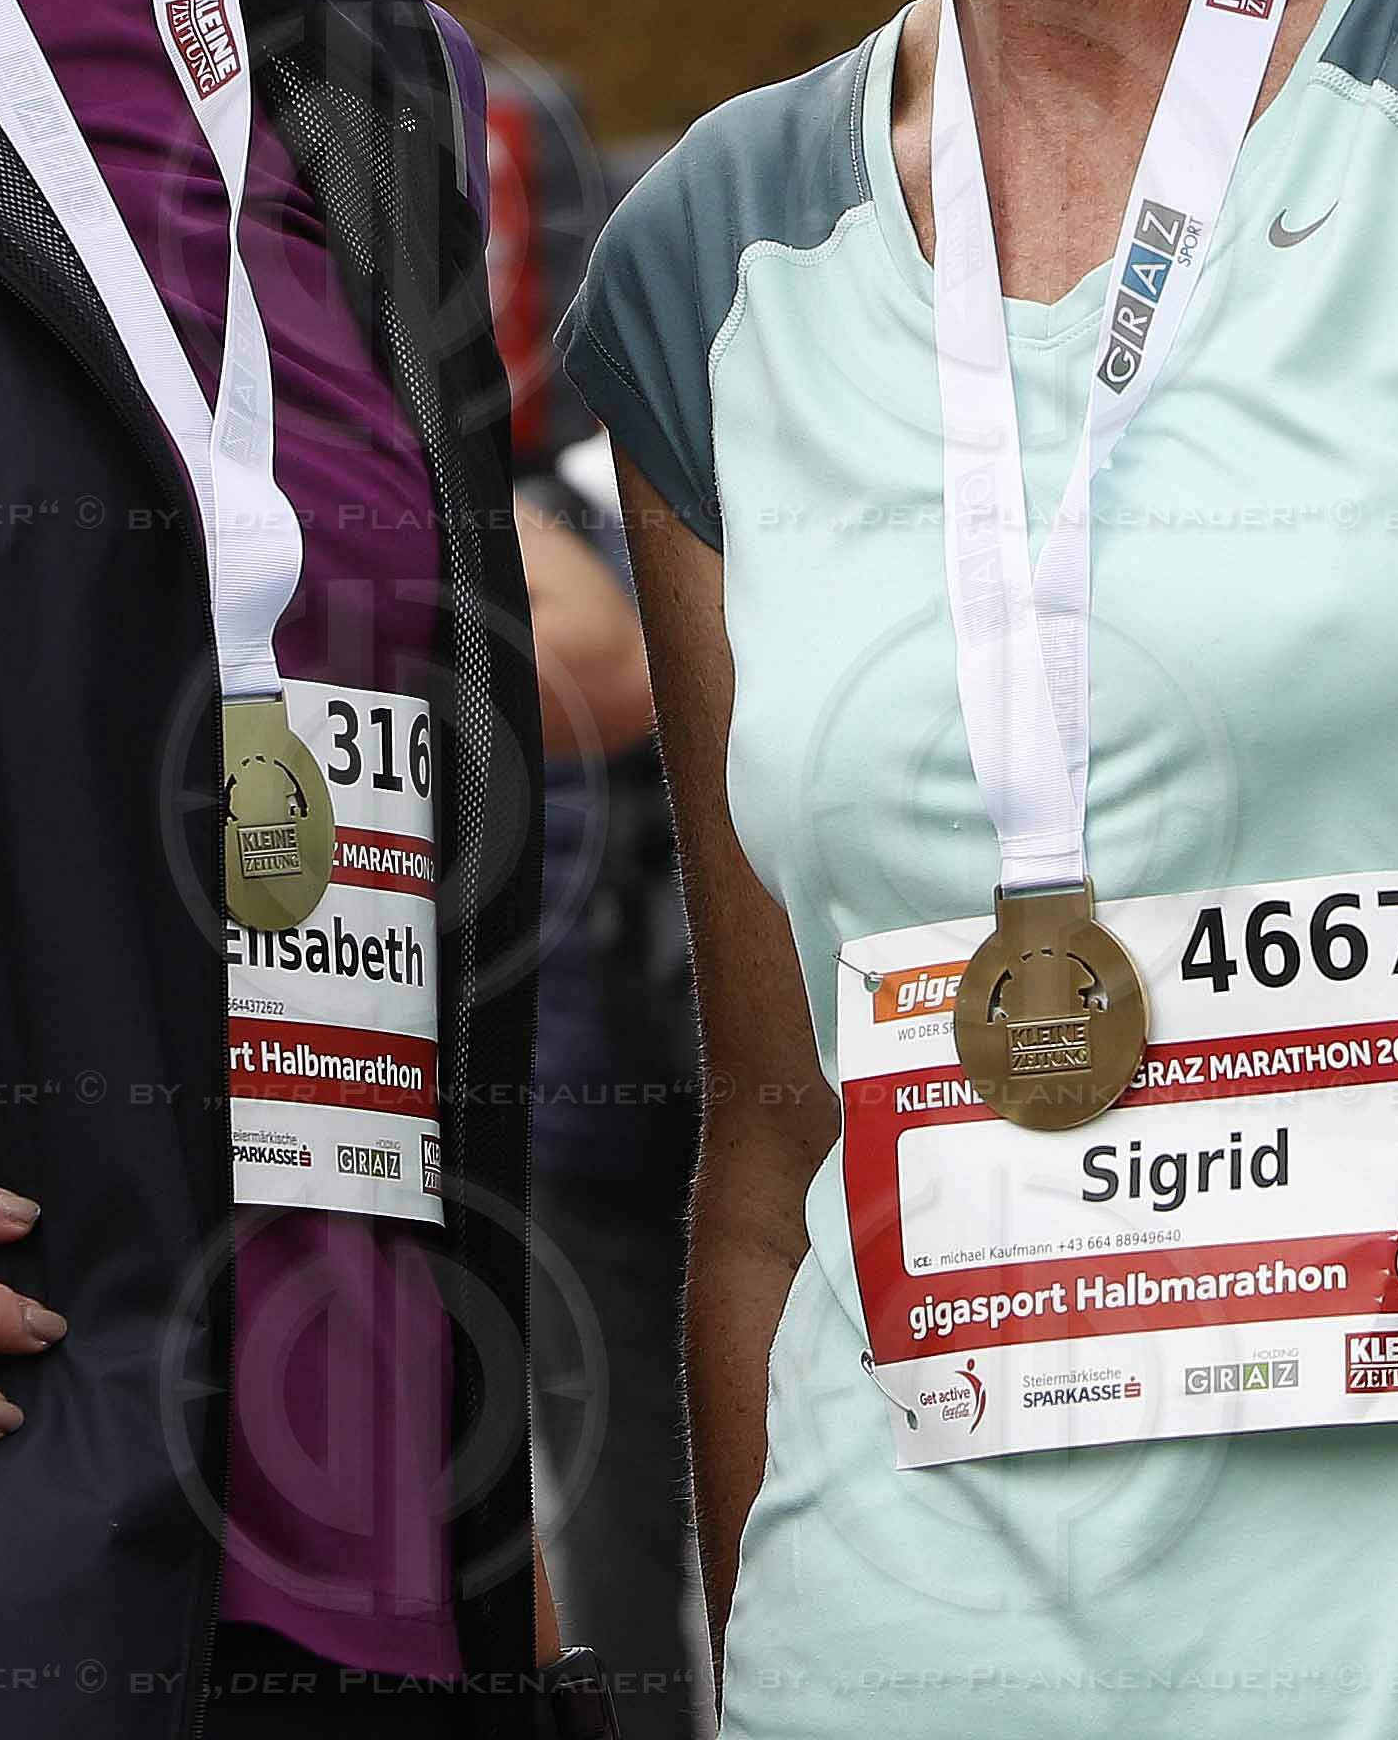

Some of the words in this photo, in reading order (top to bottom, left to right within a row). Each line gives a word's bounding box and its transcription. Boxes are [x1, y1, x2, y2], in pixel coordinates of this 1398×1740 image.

[171, 1, 217, 93] ZEITUNG
[1177, 217, 1205, 267] SPORT
[1101, 212, 1183, 388] GRAZ
[327, 698, 432, 800] 316
[242, 829, 296, 852] KLEINE
[245, 855, 299, 873] ZEITUNG
[343, 843, 430, 882] MARATHON
[898, 1027, 916, 1041] WO
[918, 1023, 940, 1038] DER
[1011, 1023, 1087, 1051] KLEINE
[260, 1040, 423, 1091] Halbmarathon
[1011, 1048, 1088, 1071] ZEITUNG
[1130, 1056, 1205, 1089] GRAZ
[1209, 1039, 1372, 1082] MARATHON
[339, 1146, 401, 1178] GRAZ
[1080, 1127, 1290, 1212] Sigrid
[940, 1247, 986, 1266] michael
[989, 1242, 1053, 1259] Kaufmann
[1058, 1237, 1084, 1253] +43
[1087, 1235, 1111, 1250] 664
[909, 1282, 1068, 1341] gigasport
[1076, 1260, 1347, 1312] Halbmarathon
[1253, 1348, 1300, 1360] HOLDING
[1022, 1367, 1122, 1388] Steiermärkische
[1186, 1363, 1297, 1393] GRAZ
[919, 1392, 938, 1407] Get
[939, 1386, 971, 1404] active
[1022, 1383, 1122, 1409] SPARKASSE
